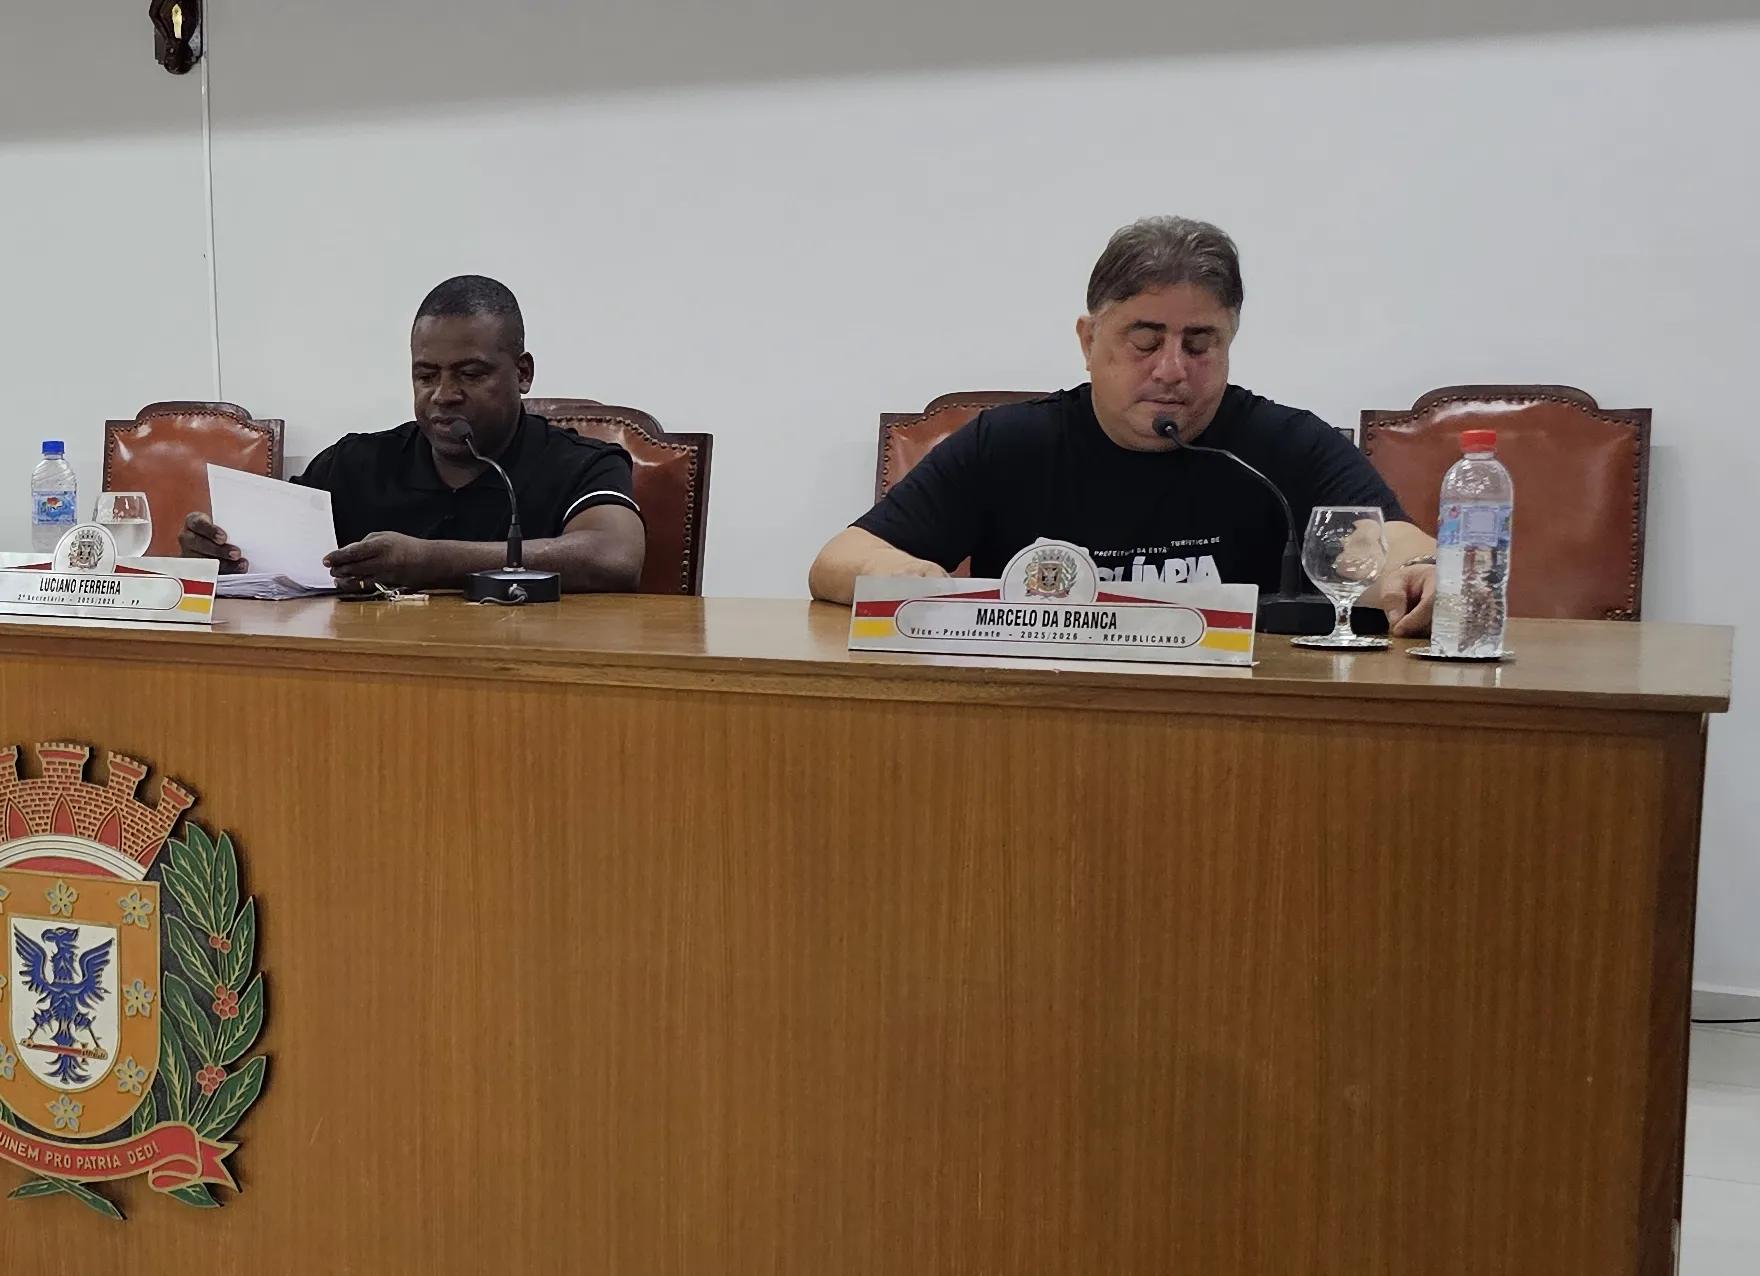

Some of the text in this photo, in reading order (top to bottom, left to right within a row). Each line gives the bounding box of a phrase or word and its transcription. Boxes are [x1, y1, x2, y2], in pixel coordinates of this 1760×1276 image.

[40, 577, 121, 595] LUCIANO FERREIRA
[77, 596, 115, 605] 2025/2026
[975, 608, 1118, 630] MARCELO DA BRANCA
[1020, 630, 1079, 641] 2025/2026
[1102, 633, 1187, 645] REPUBLICANOS
[44, 1151, 72, 1168] PRO
[76, 1155, 122, 1170] PATRIA
